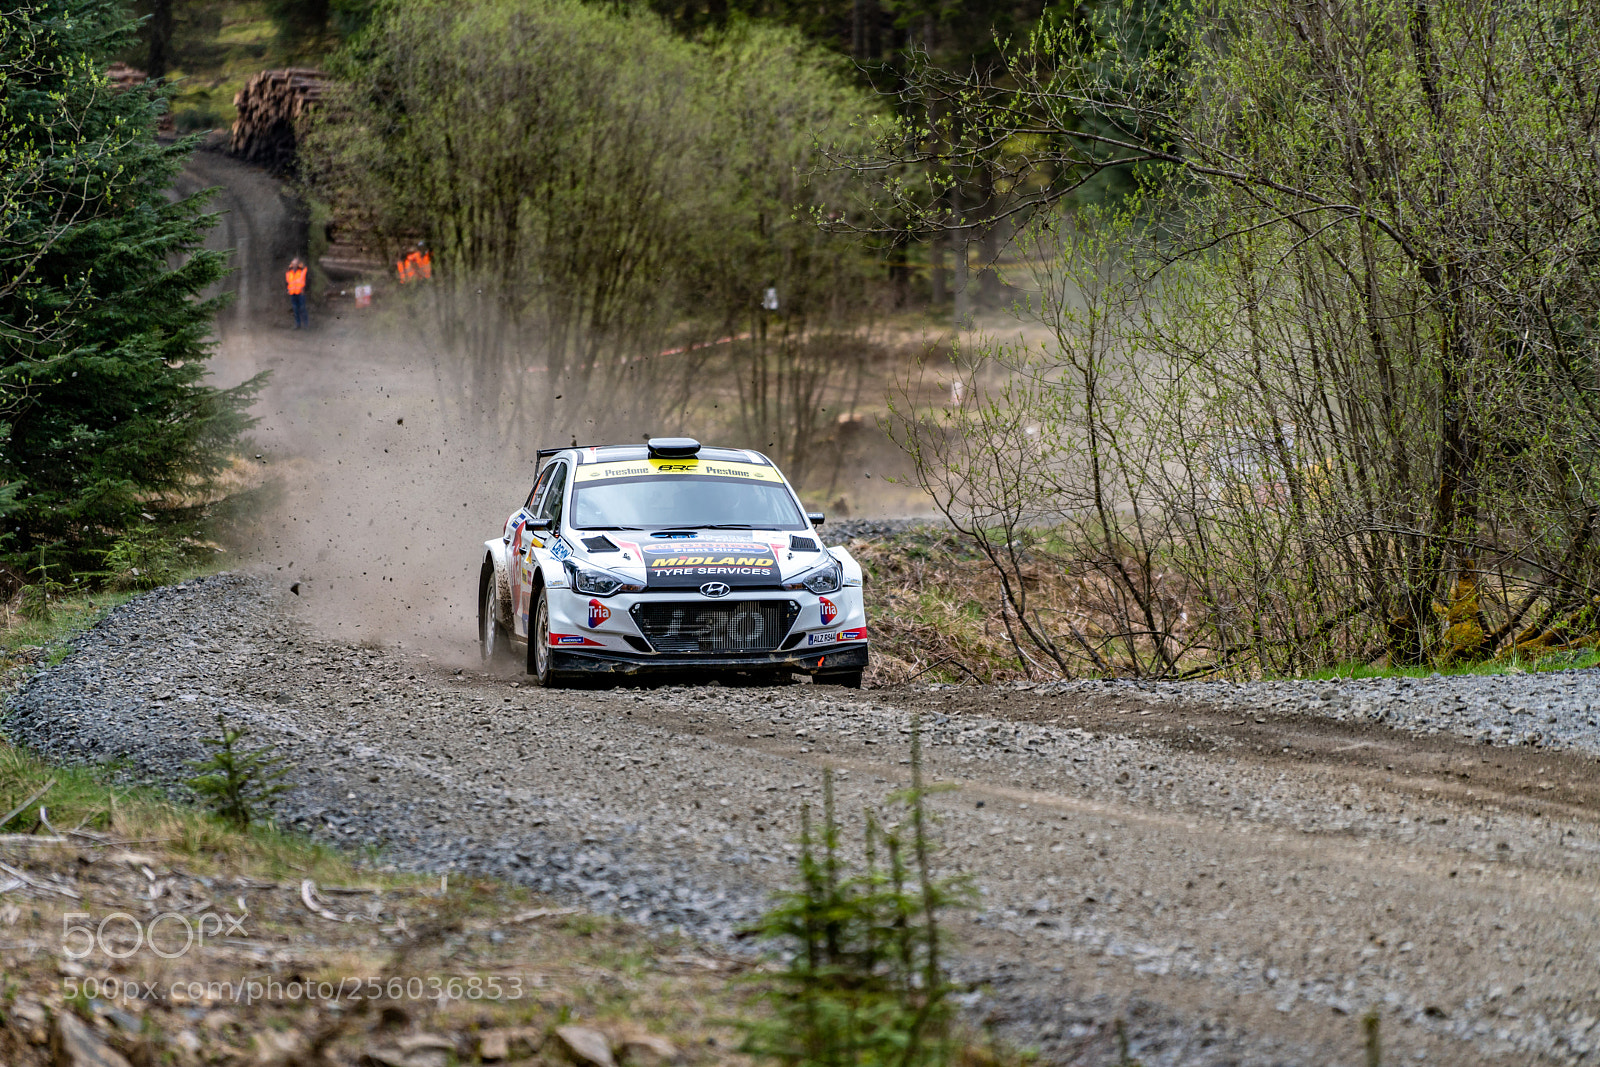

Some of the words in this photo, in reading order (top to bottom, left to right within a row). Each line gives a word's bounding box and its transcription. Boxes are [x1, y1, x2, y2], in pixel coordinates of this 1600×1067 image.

[605, 467, 649, 477] Prestone
[706, 466, 750, 477] Prestone
[654, 568, 693, 577] TYRE
[697, 567, 771, 576] SERVICES
[589, 605, 609, 618] Tria
[820, 602, 837, 615] Tria
